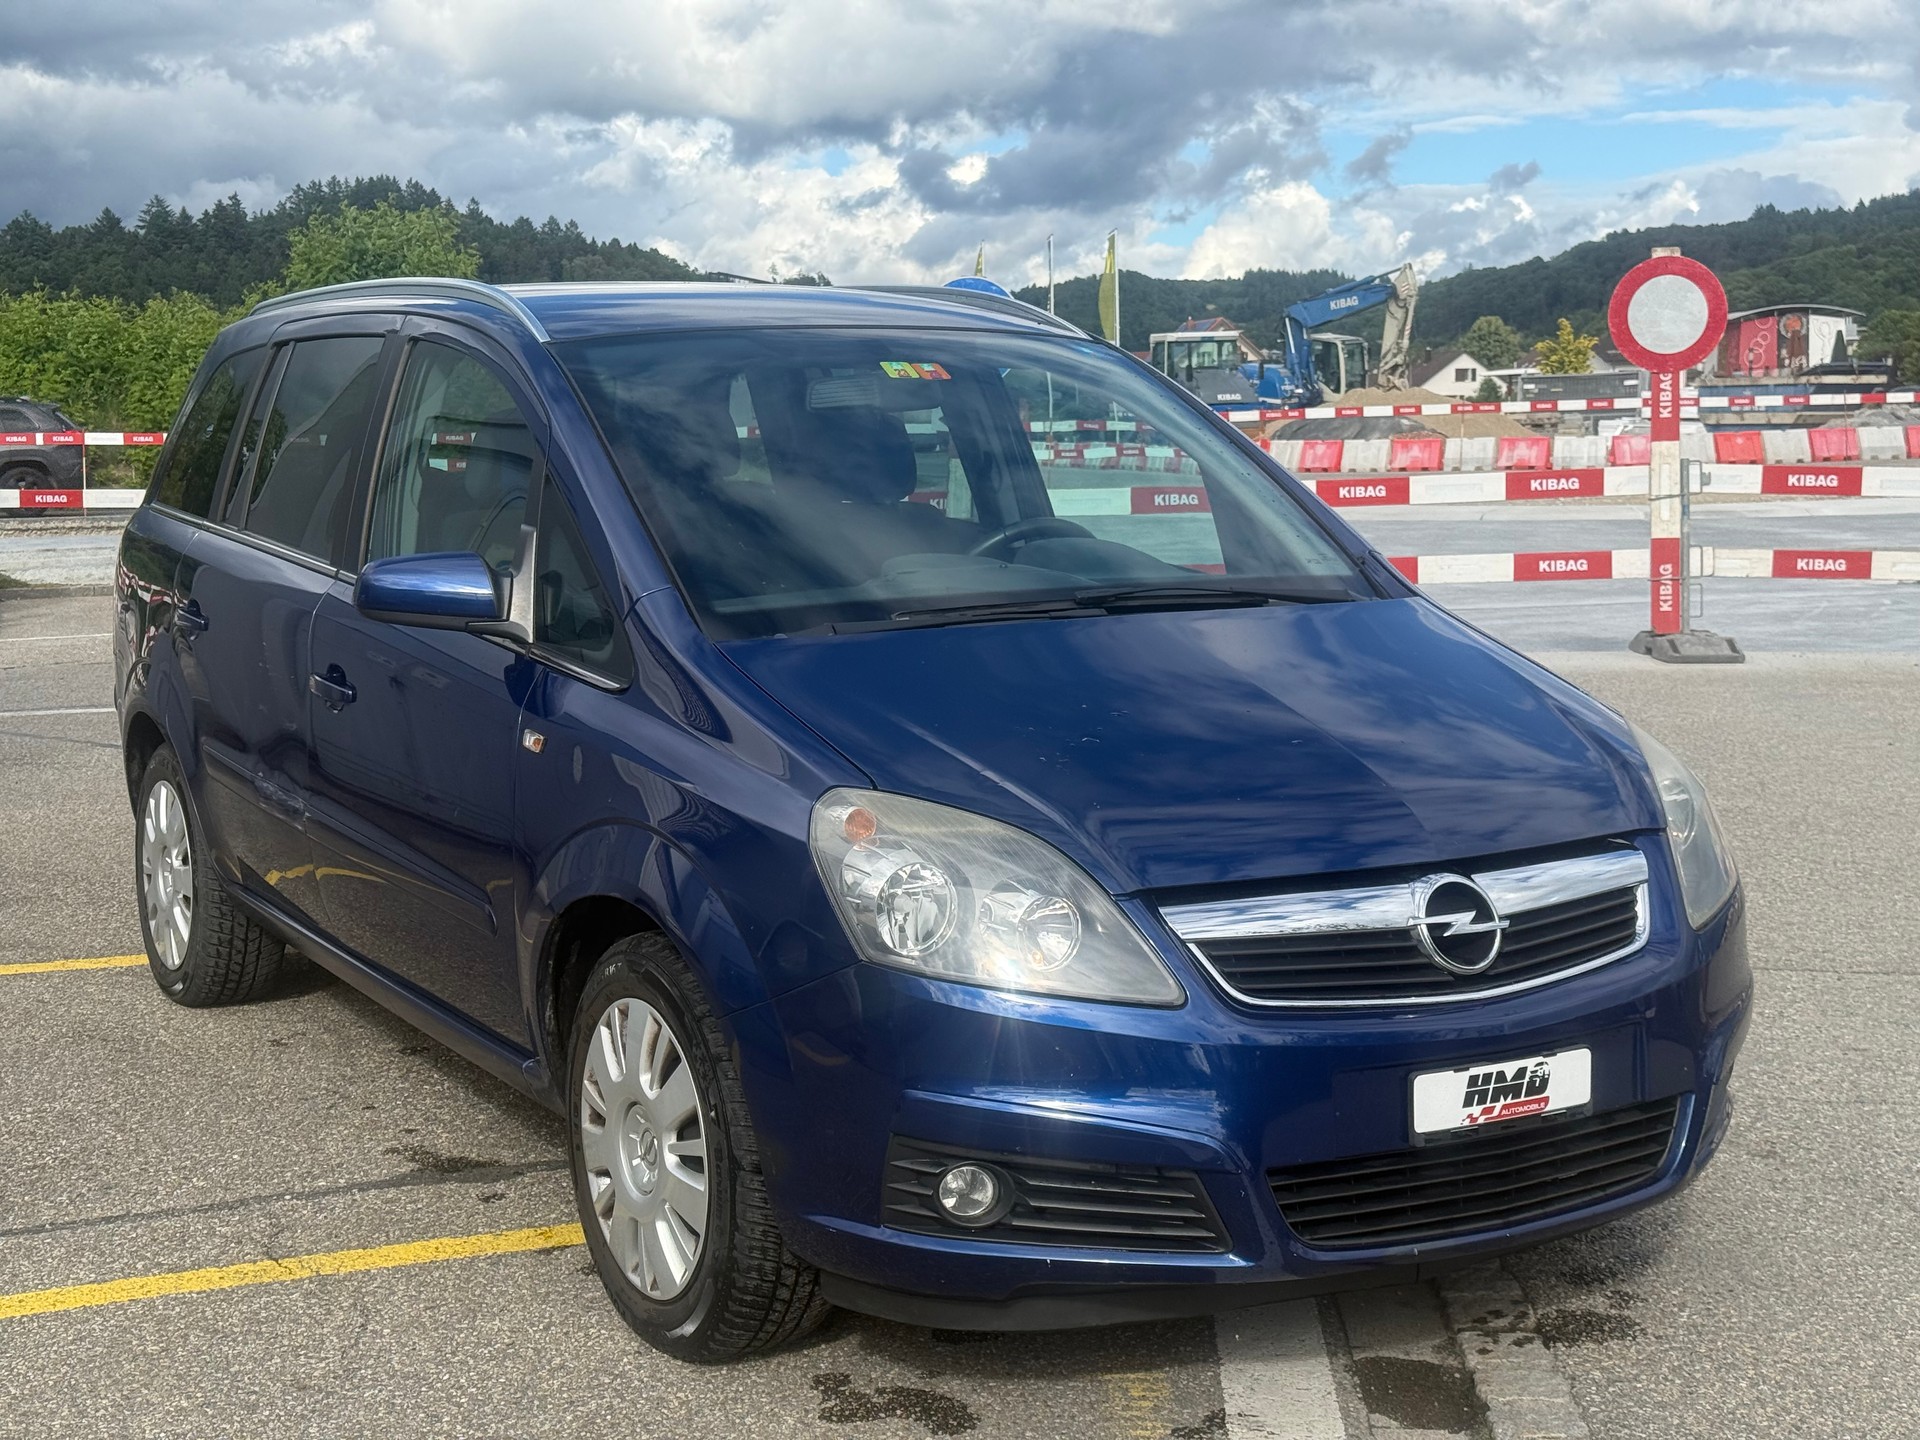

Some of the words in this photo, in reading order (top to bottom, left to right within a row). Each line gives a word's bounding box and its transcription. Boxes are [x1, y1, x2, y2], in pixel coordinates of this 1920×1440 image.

[1329, 296, 1359, 310] KIBAG
[1217, 393, 1242, 401] KIBAG
[1658, 373, 1673, 418] KIBAG
[1530, 477, 1580, 491] KIBAG
[1787, 474, 1838, 488] KIBAG
[1339, 485, 1386, 498] KIBAG
[35, 495, 68, 503] KIBAG
[1154, 494, 1199, 507] KIBAG
[1538, 559, 1588, 573] KIBAG
[1796, 557, 1847, 572] KIBAG
[1658, 563, 1673, 612] KIBAG
[1501, 1101, 1546, 1116] AUTOMOBILE
